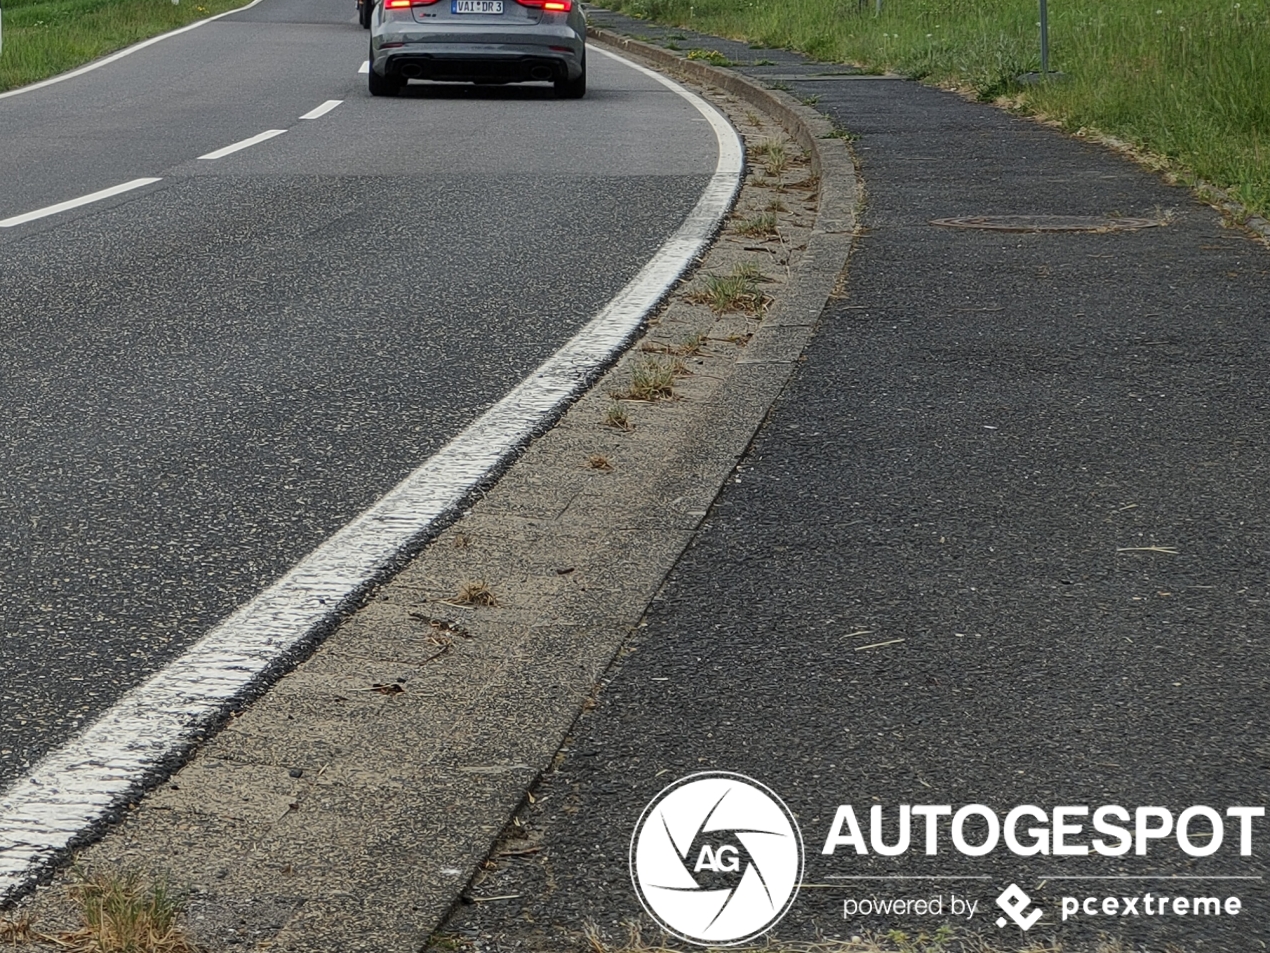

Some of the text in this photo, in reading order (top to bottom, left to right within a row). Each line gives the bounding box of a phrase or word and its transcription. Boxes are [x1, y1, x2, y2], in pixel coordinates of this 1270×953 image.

[458, 1, 502, 12] VAI DR 3
